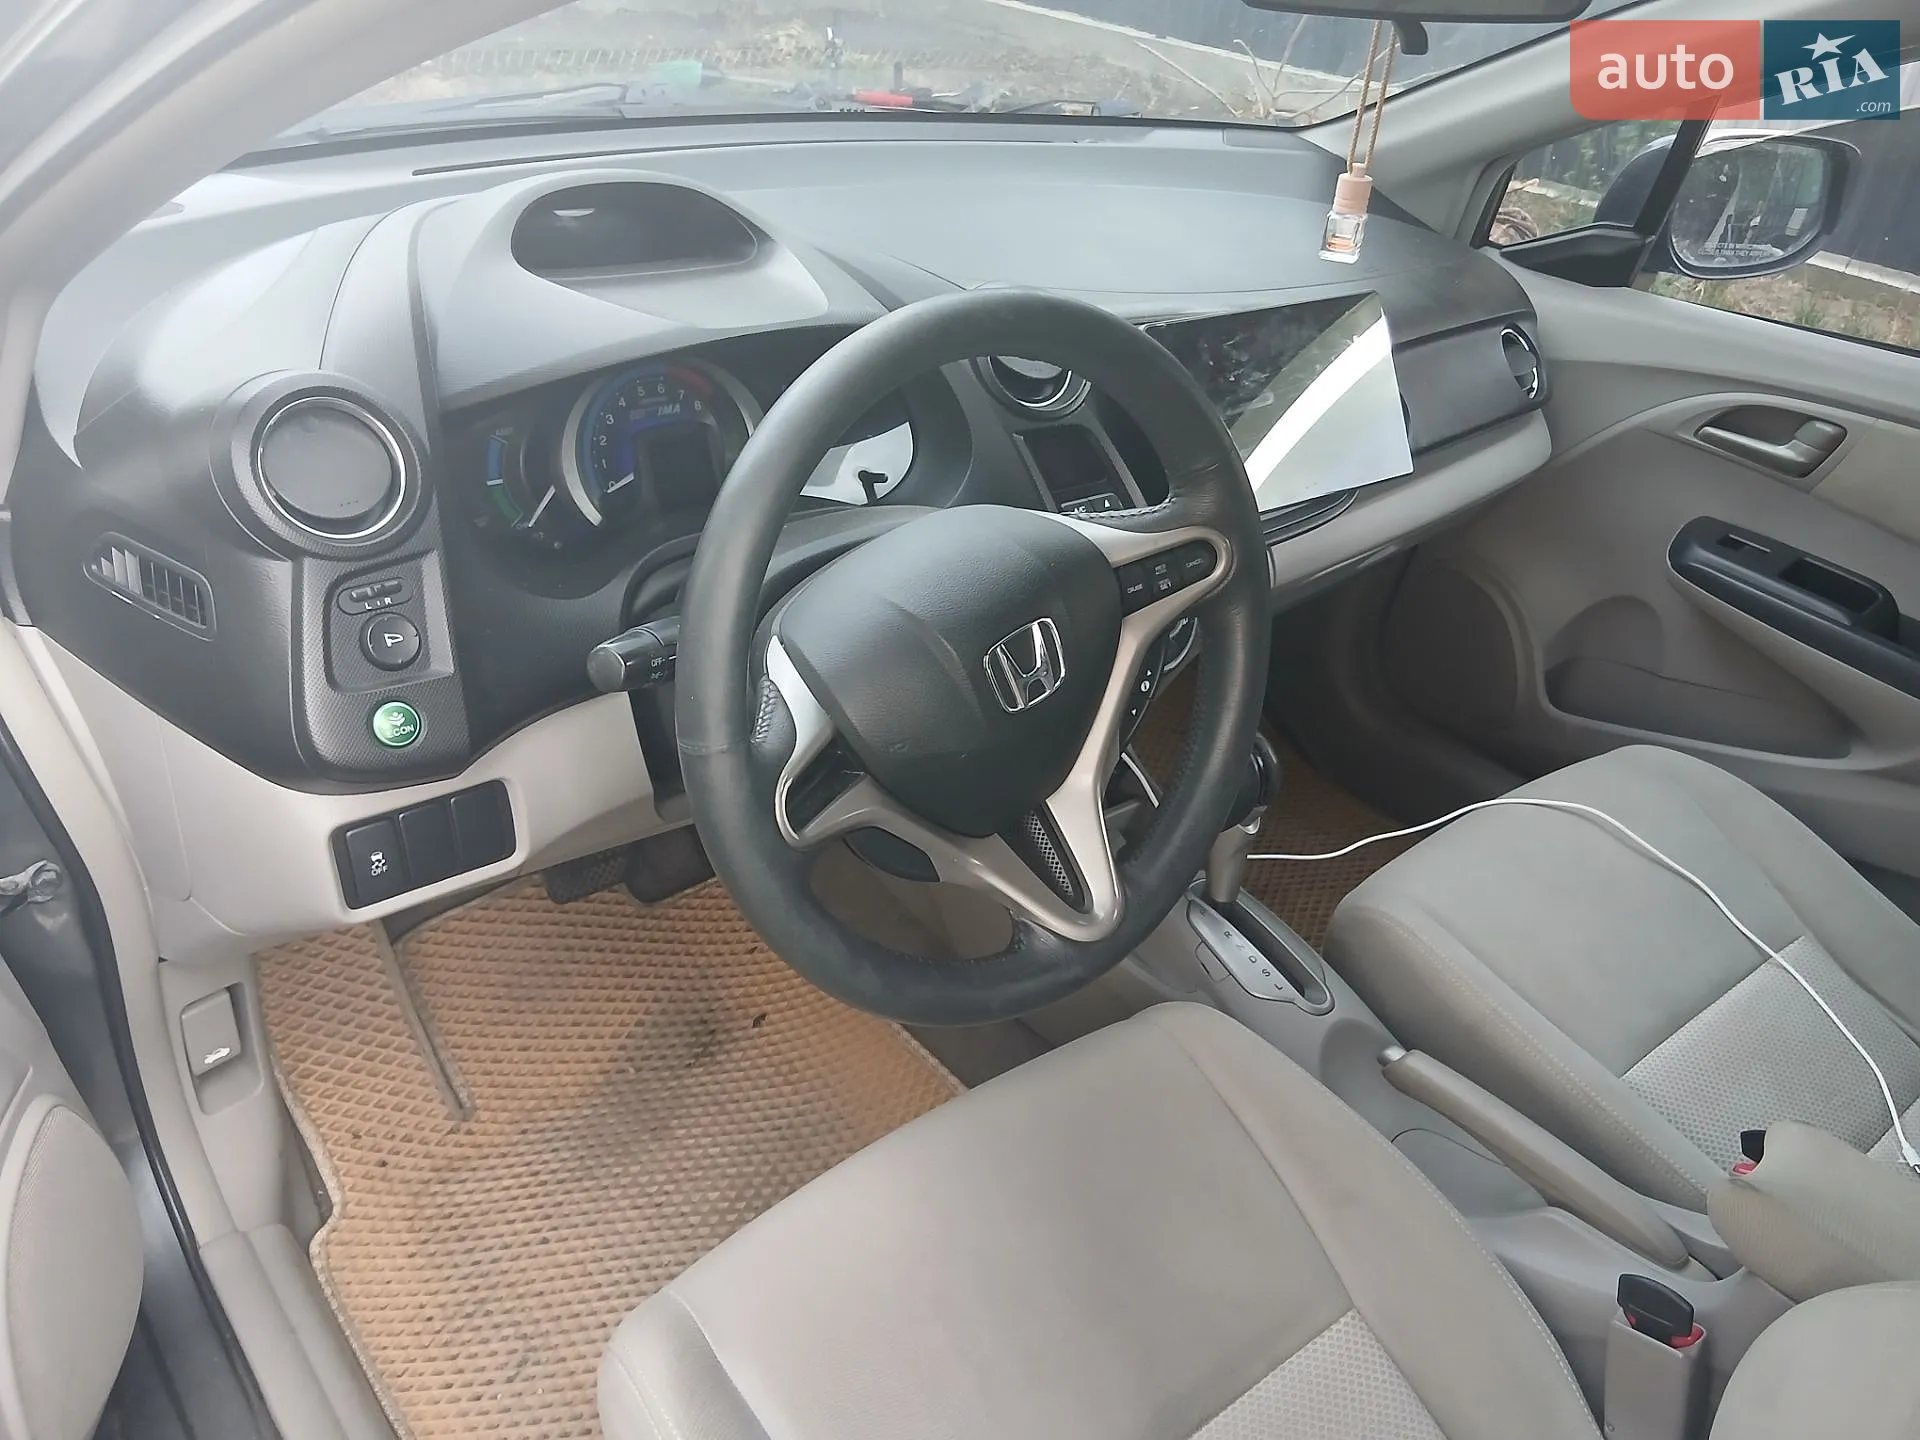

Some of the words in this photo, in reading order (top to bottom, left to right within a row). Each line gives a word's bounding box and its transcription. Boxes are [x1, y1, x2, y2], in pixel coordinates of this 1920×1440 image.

[637, 386, 646, 397] 5
[657, 383, 665, 394] 6
[678, 389, 686, 400] 7
[618, 396, 626, 408] 4
[694, 400, 702, 411] 8
[605, 414, 615, 425] 3
[599, 435, 608, 446] 2
[601, 459, 607, 469] 1
[365, 602, 373, 610] L
[384, 597, 393, 605] R
